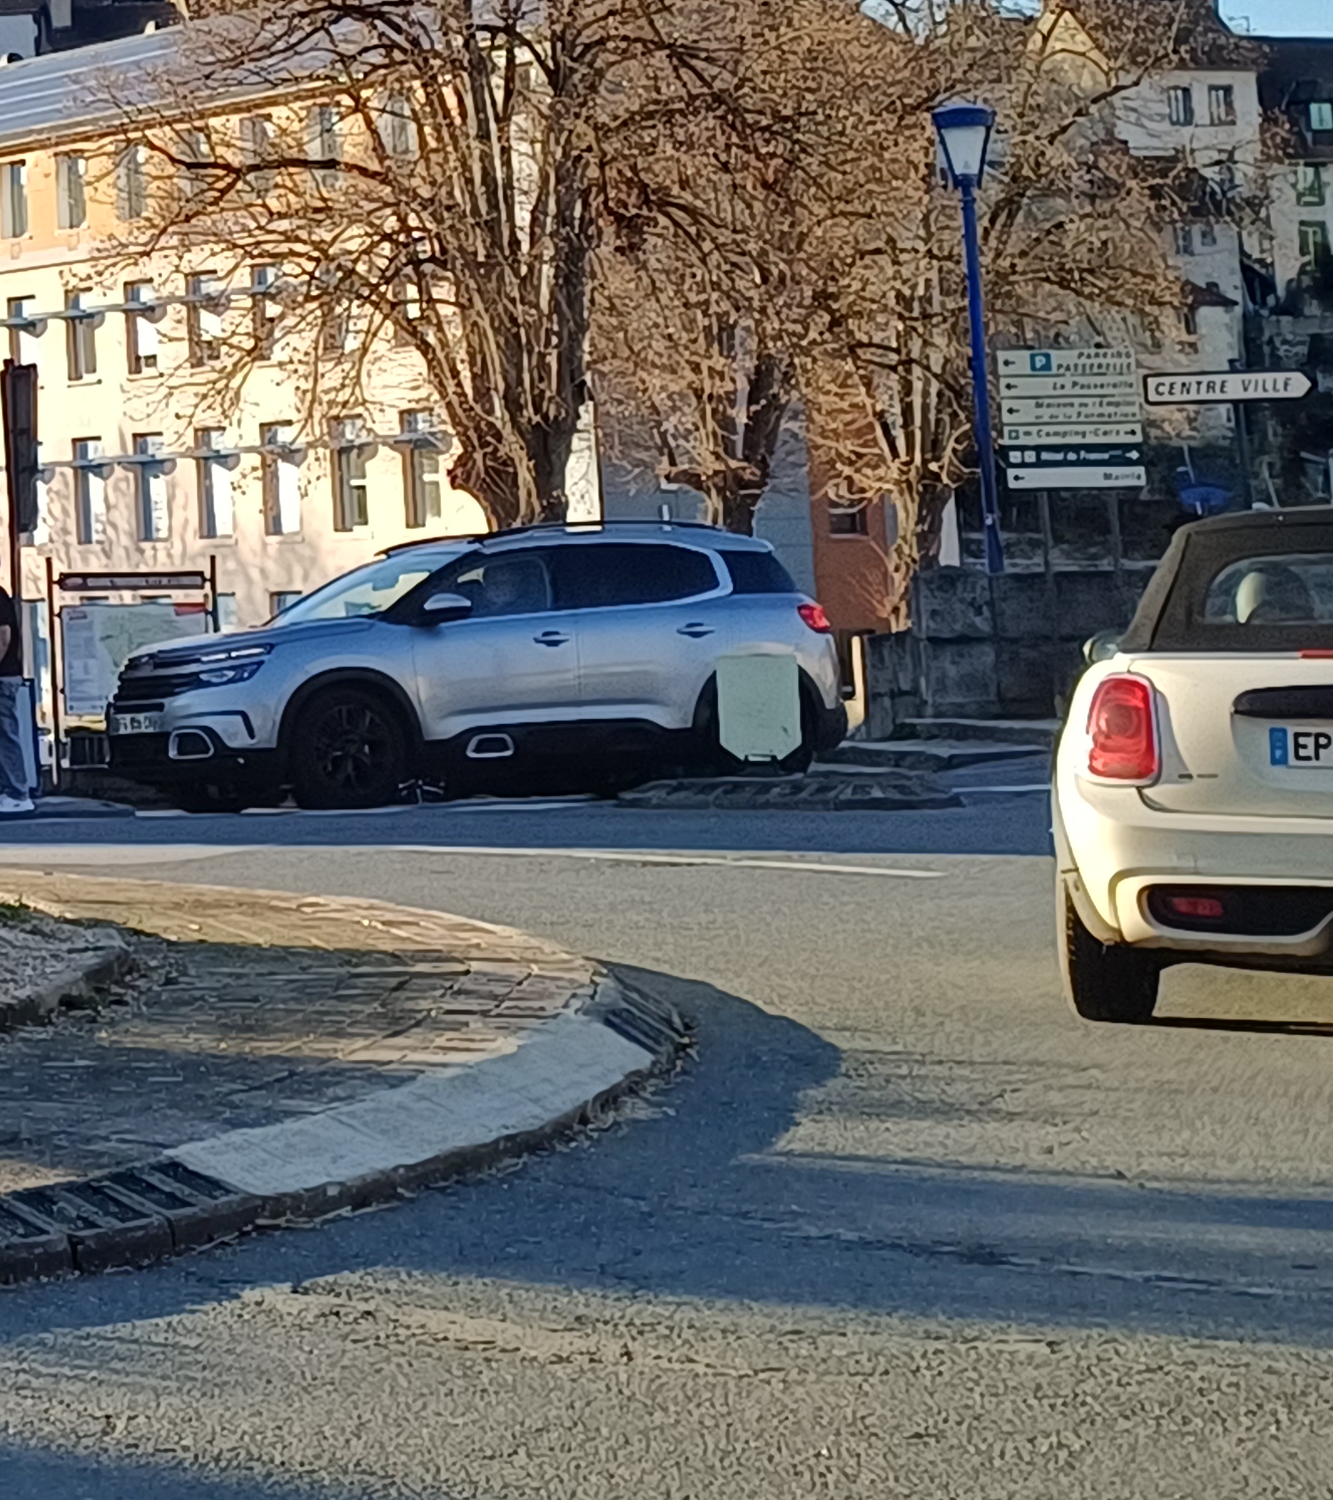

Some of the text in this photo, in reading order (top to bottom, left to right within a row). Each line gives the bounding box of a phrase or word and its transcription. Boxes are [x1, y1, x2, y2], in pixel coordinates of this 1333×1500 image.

[1154, 376, 1293, 396] CENTRE VILLE
[1293, 731, 1332, 762] EP
